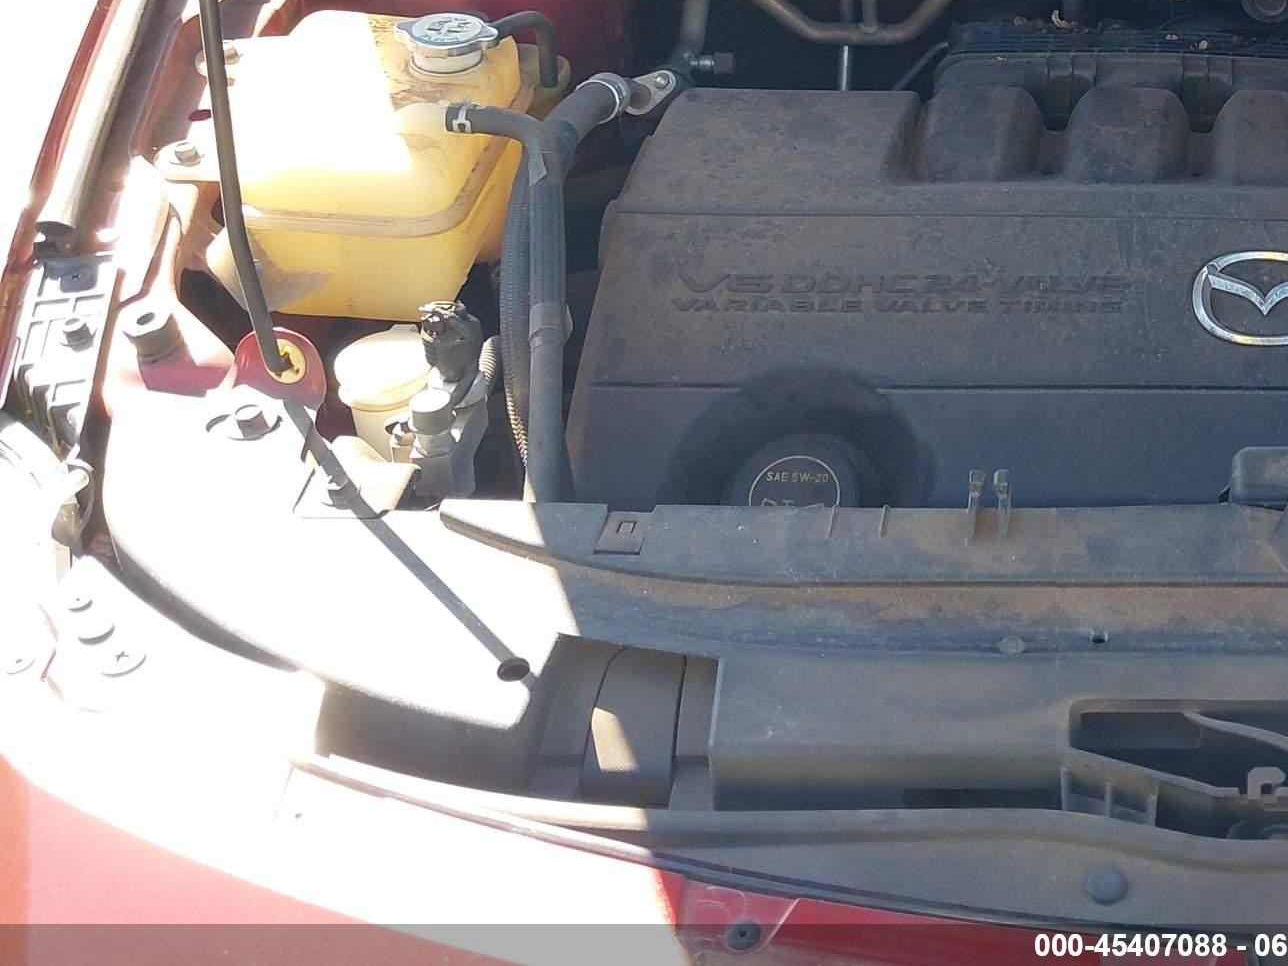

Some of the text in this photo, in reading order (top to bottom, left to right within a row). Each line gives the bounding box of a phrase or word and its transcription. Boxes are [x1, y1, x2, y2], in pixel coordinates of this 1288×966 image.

[678, 272, 773, 294] V6
[781, 273, 919, 295] DOHC
[671, 297, 1122, 315] VARIABLE VALVE TIMING
[766, 471, 829, 483] SAE 5W-20
